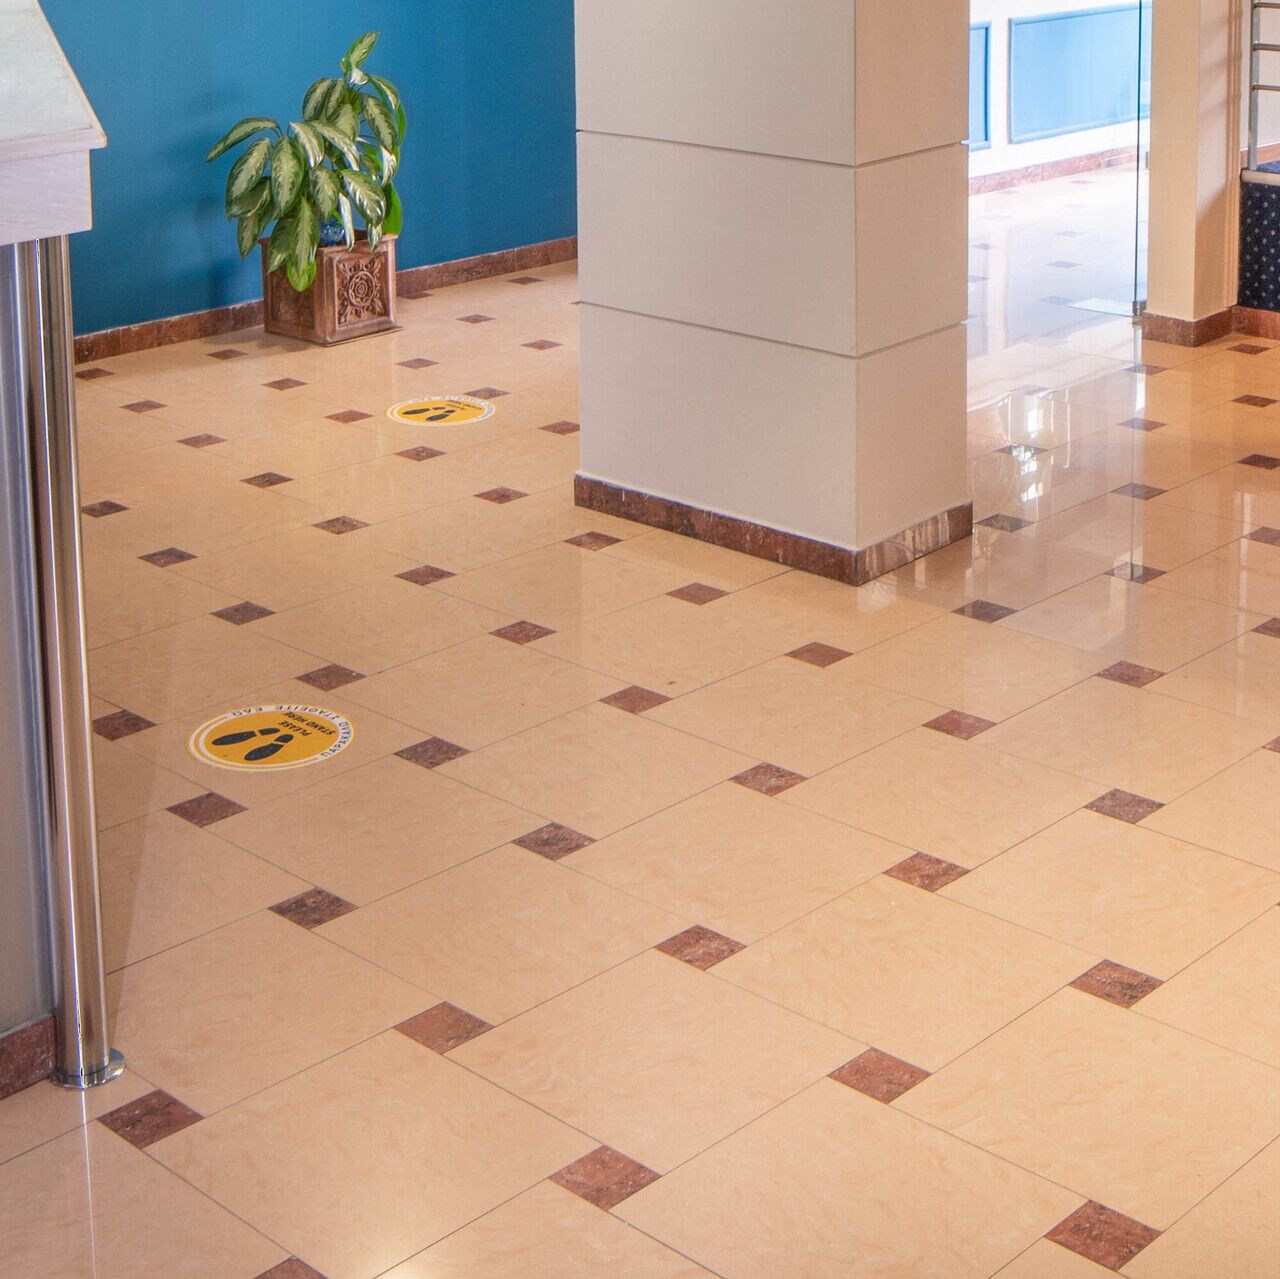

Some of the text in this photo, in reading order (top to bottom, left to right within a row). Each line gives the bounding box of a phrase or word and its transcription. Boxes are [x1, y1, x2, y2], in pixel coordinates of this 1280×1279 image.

[278, 720, 312, 736] PLEASE
[283, 711, 336, 736] STAND HERE
